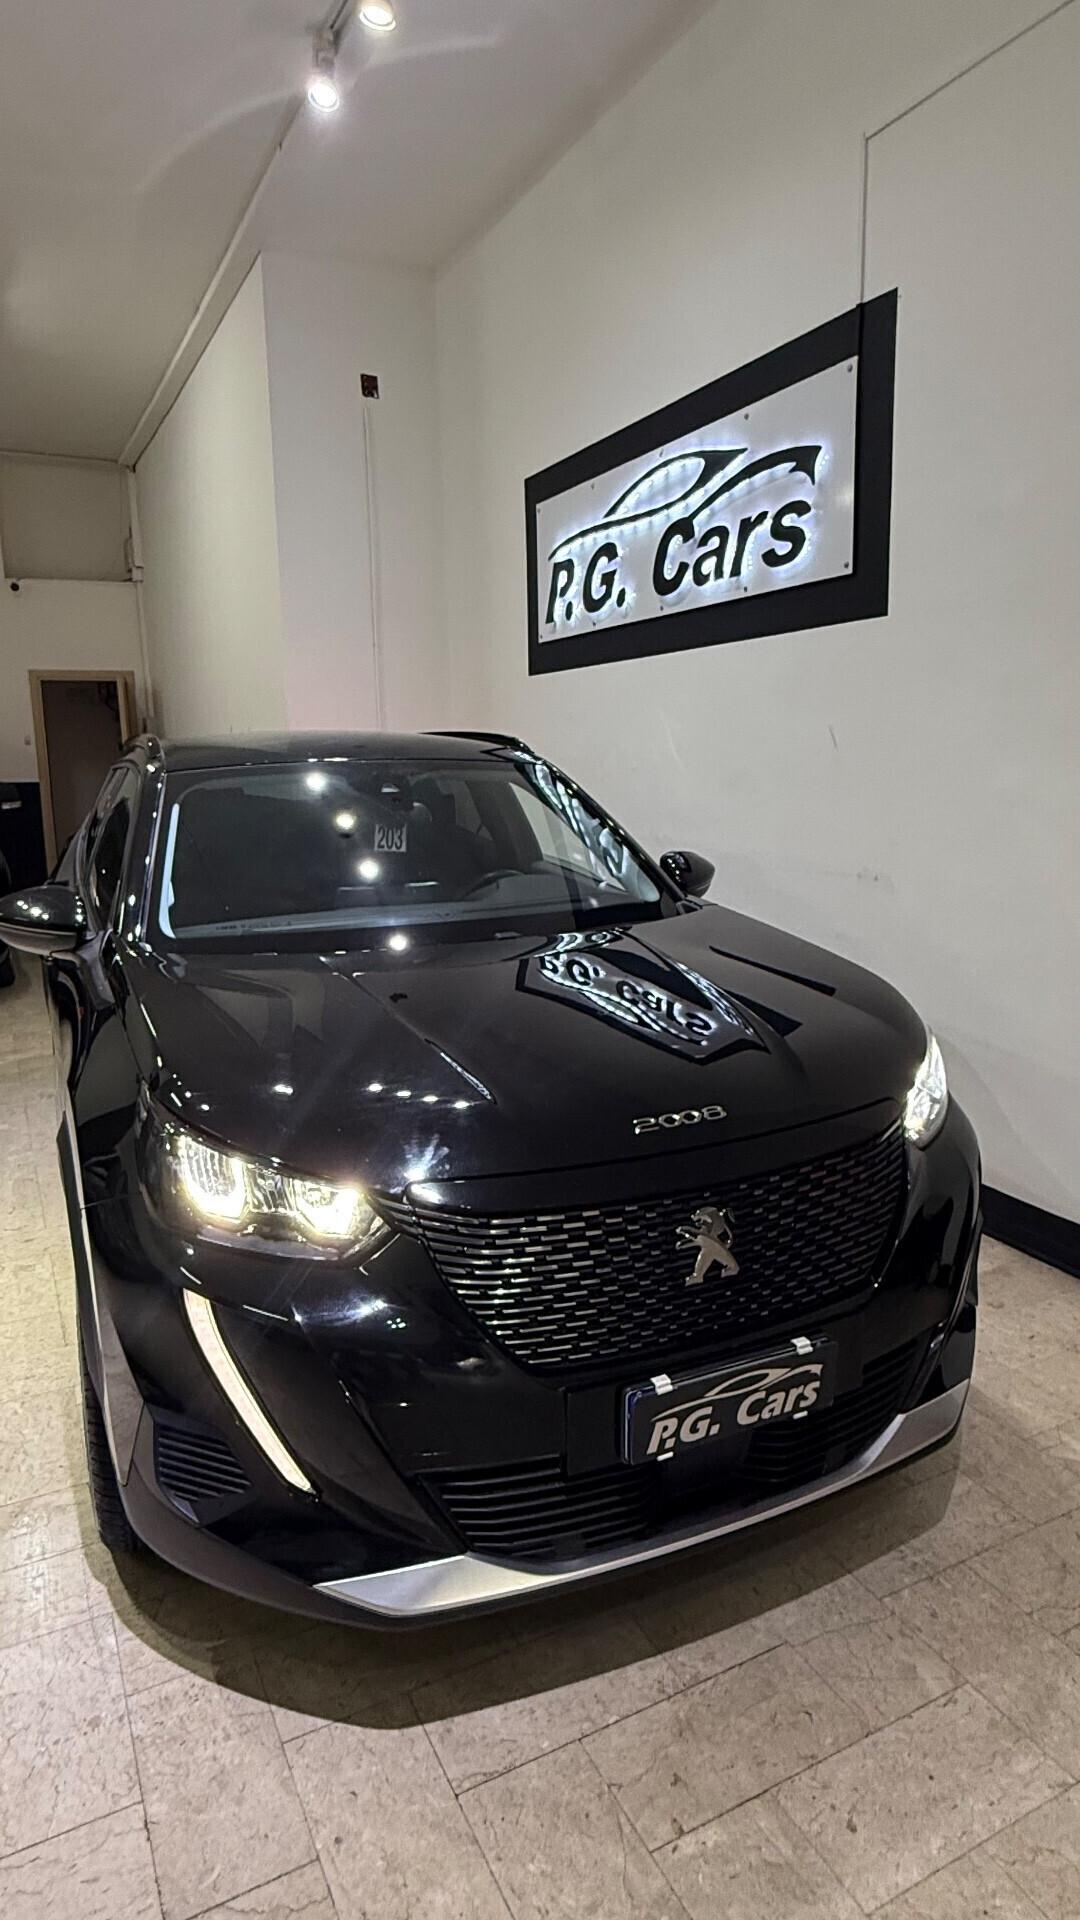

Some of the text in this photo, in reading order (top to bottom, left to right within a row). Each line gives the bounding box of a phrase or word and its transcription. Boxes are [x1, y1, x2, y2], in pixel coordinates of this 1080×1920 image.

[545, 499, 812, 625] P.G. Cars
[377, 825, 403, 850] 203
[632, 1105, 728, 1135] 2008
[646, 1380, 821, 1455] P.G. Cars
